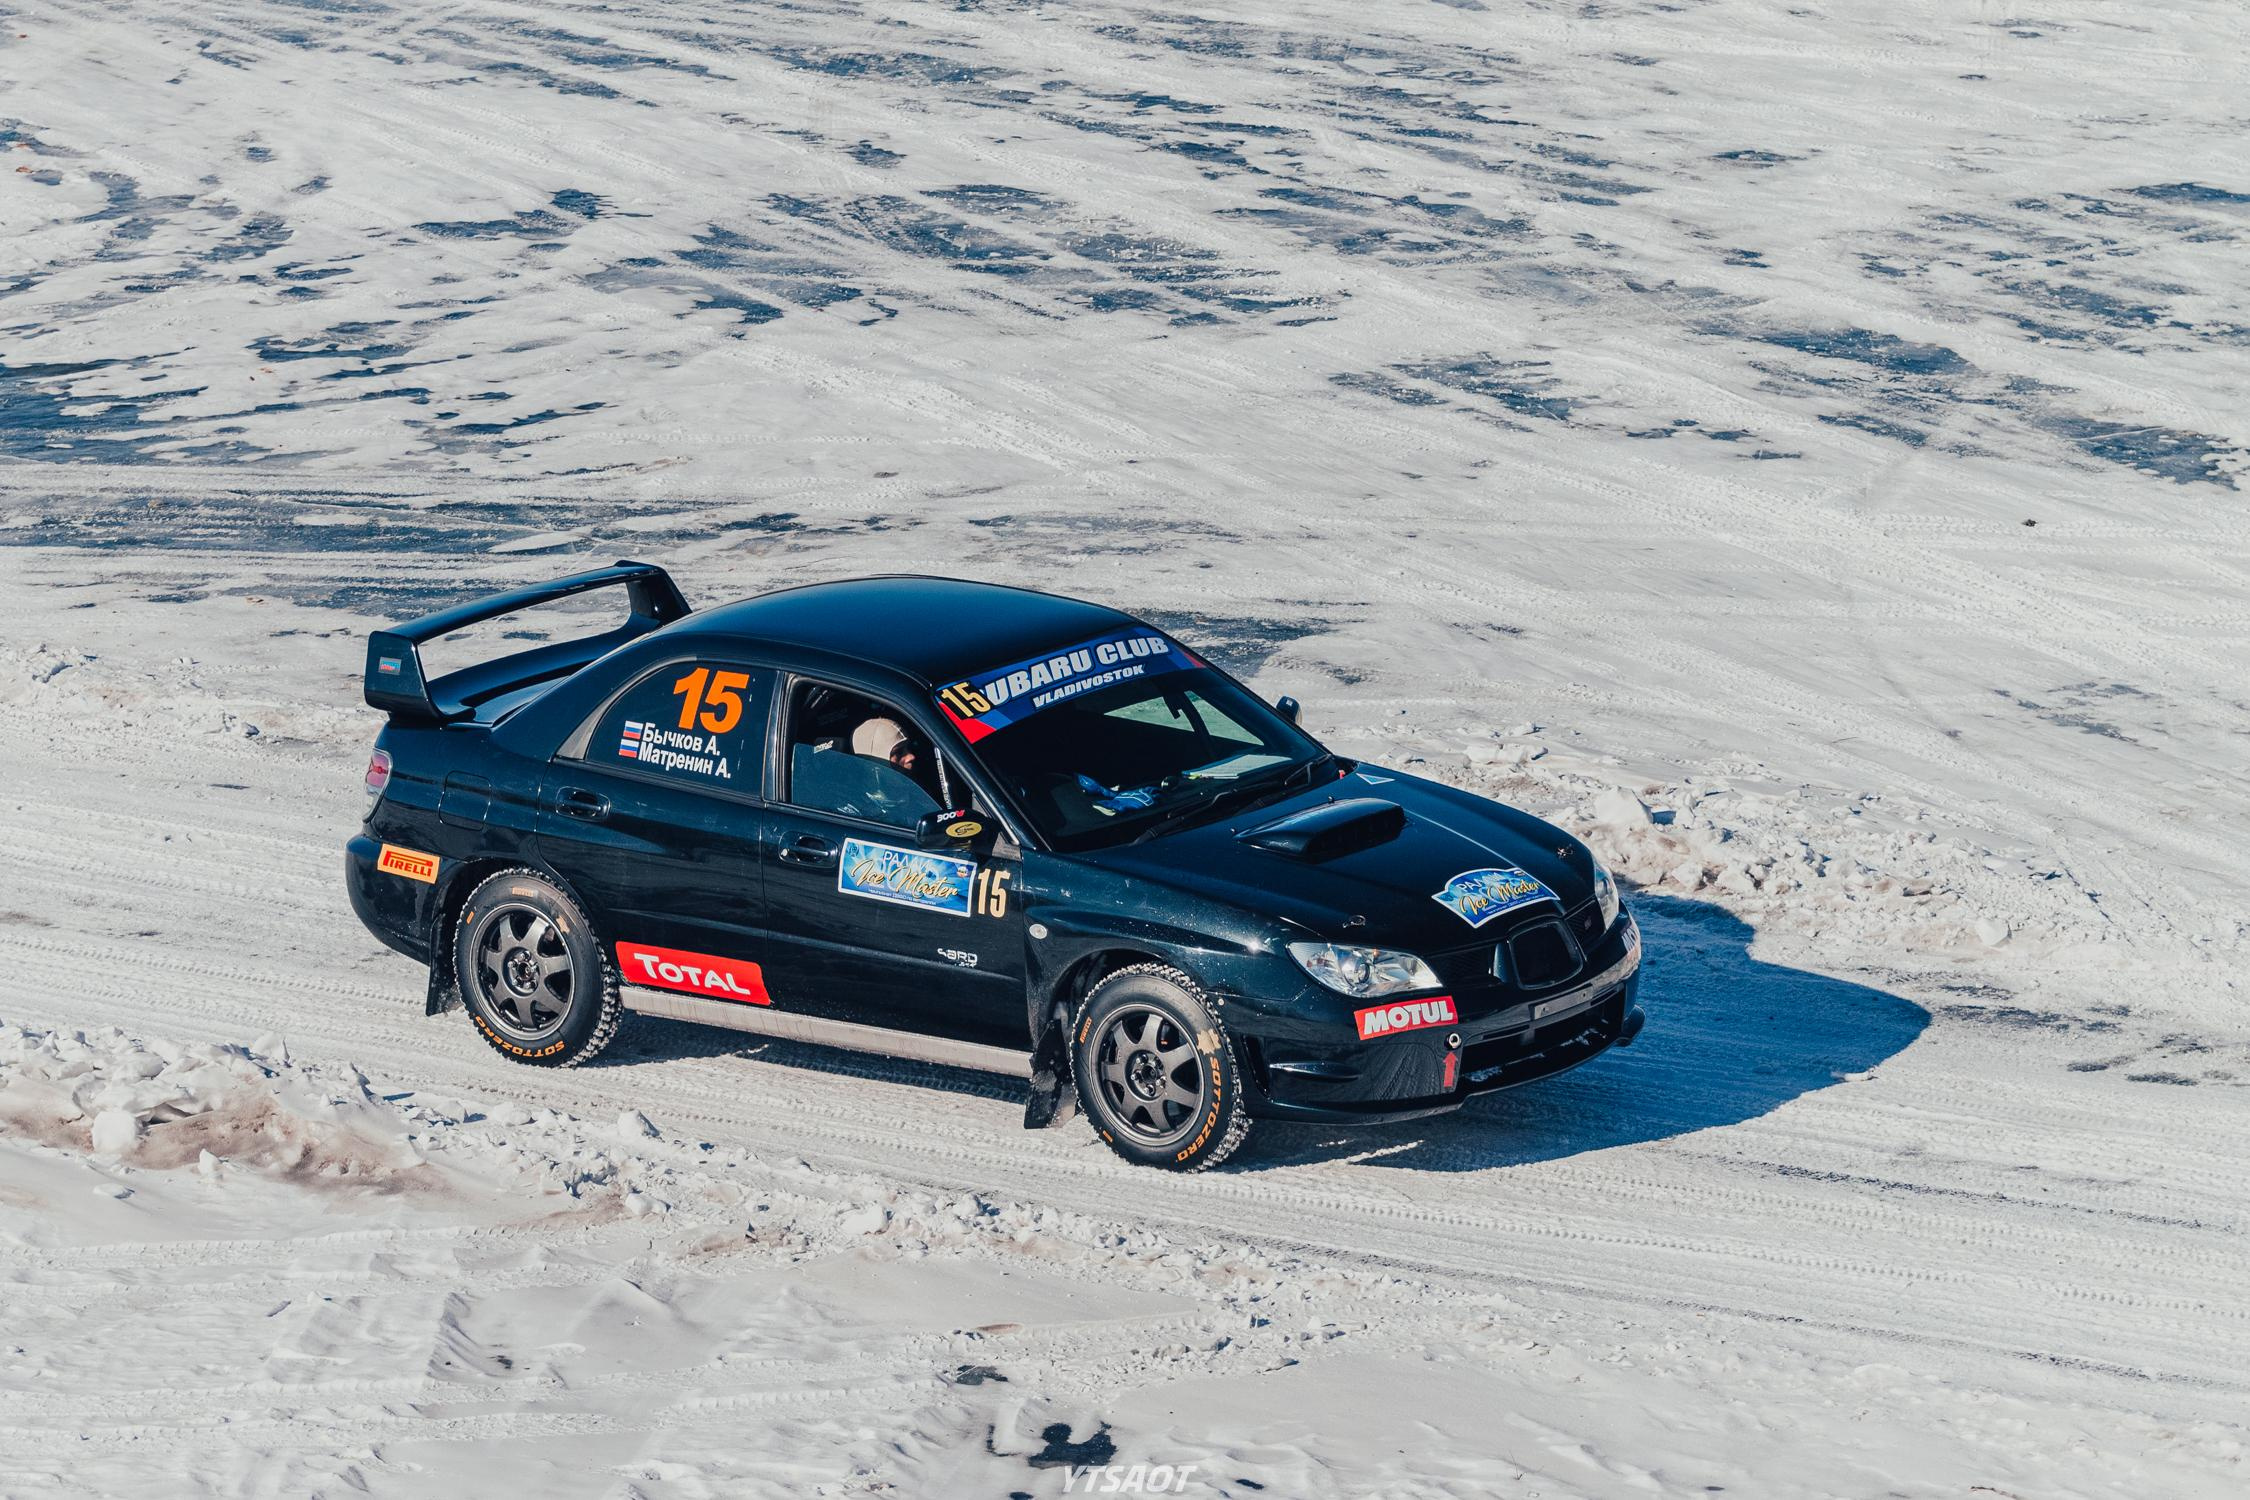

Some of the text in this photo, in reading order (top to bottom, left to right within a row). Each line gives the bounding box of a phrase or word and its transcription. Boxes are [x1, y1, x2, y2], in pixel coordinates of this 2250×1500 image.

[979, 636, 1169, 706] UBARU CLUB
[1032, 664, 1144, 707] VLADIVOSTOK
[673, 667, 750, 734] 15
[940, 680, 991, 718] 15
[642, 722, 721, 756] Бычков А.
[638, 742, 731, 779] Матренин А.
[382, 850, 434, 877] PIRELLI
[851, 859, 886, 888] Ice
[888, 864, 959, 900] Master
[977, 868, 1011, 918] 15
[1459, 893, 1489, 916] Ice
[1486, 879, 1541, 902] Master
[633, 952, 751, 995] TOTAL
[475, 1015, 565, 1058] SOTTOZERO
[1363, 1000, 1454, 1035] MOTUL
[1176, 1056, 1222, 1162] SOTTOZERO
